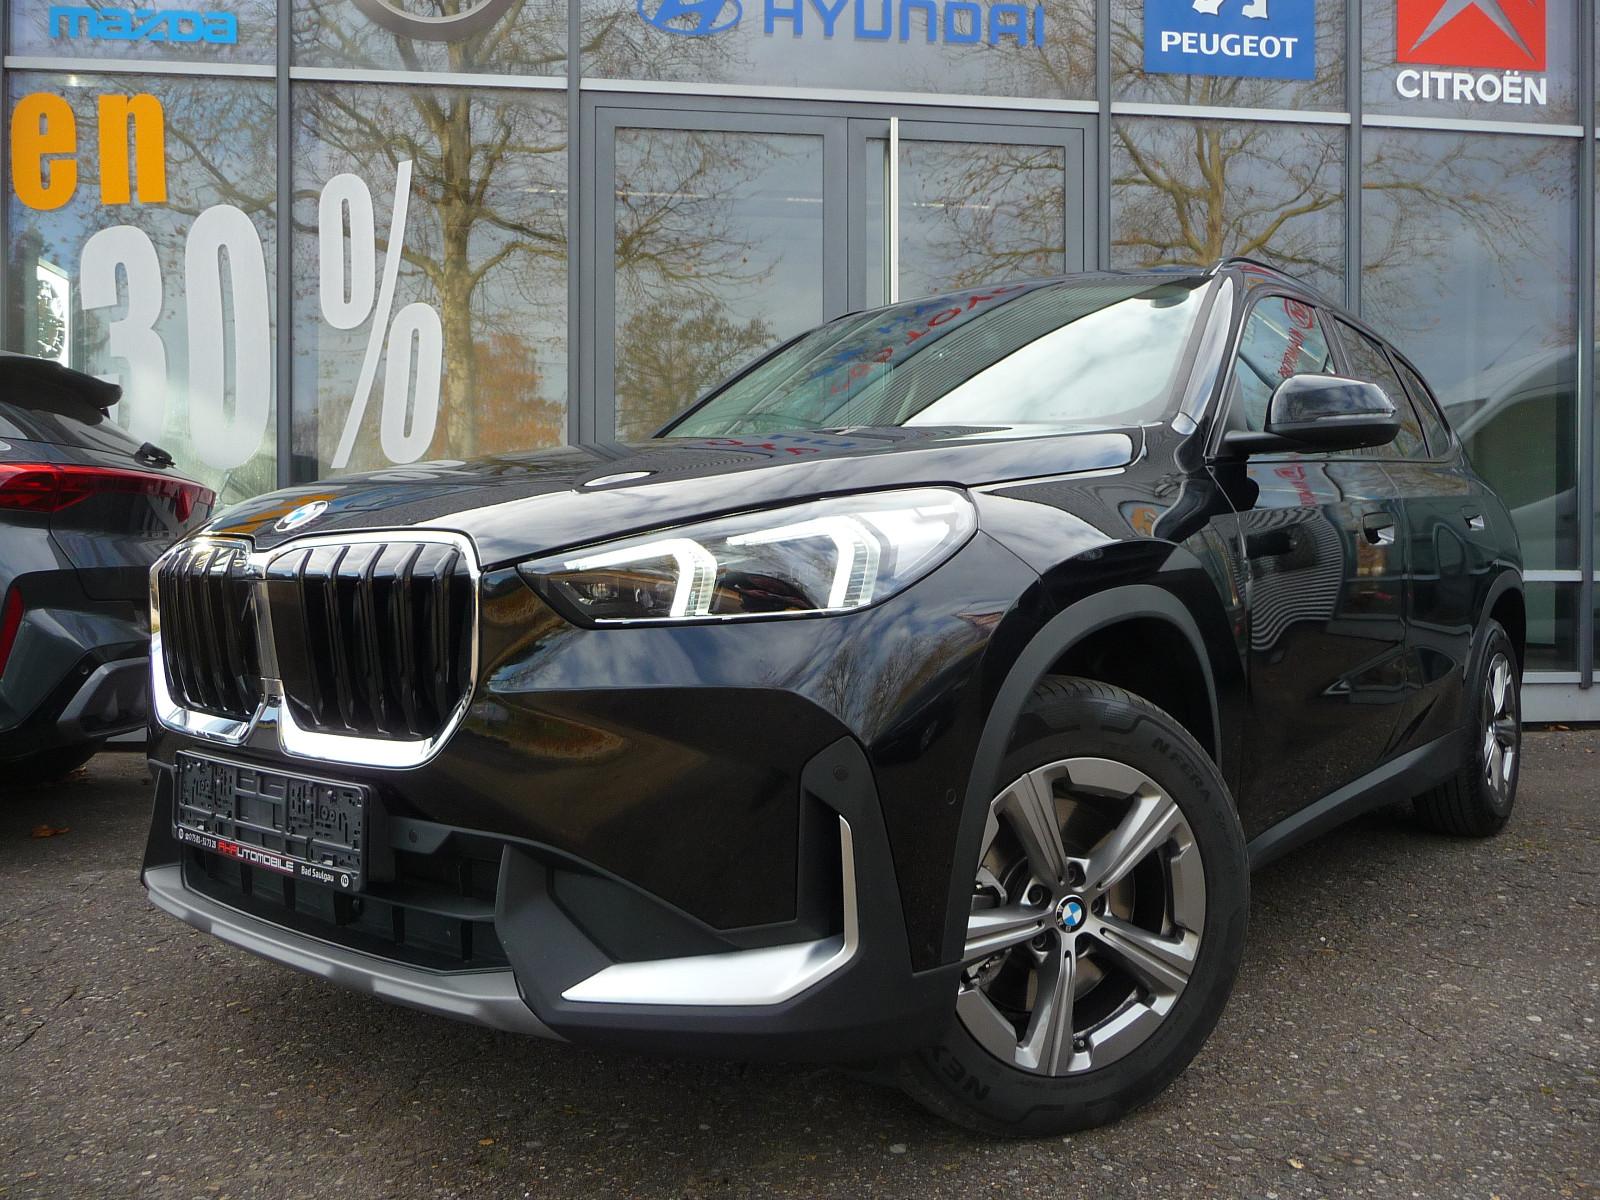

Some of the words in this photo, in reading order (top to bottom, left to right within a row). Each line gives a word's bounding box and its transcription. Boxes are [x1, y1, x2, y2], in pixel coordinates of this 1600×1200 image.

[764, 0, 1045, 48] HYUNDAI
[1161, 31, 1298, 59] PEUGEOT
[1396, 70, 1547, 105] CITROËN
[11, 92, 167, 211] en
[301, 865, 312, 876] Bad
[312, 868, 335, 882] Saulgau
